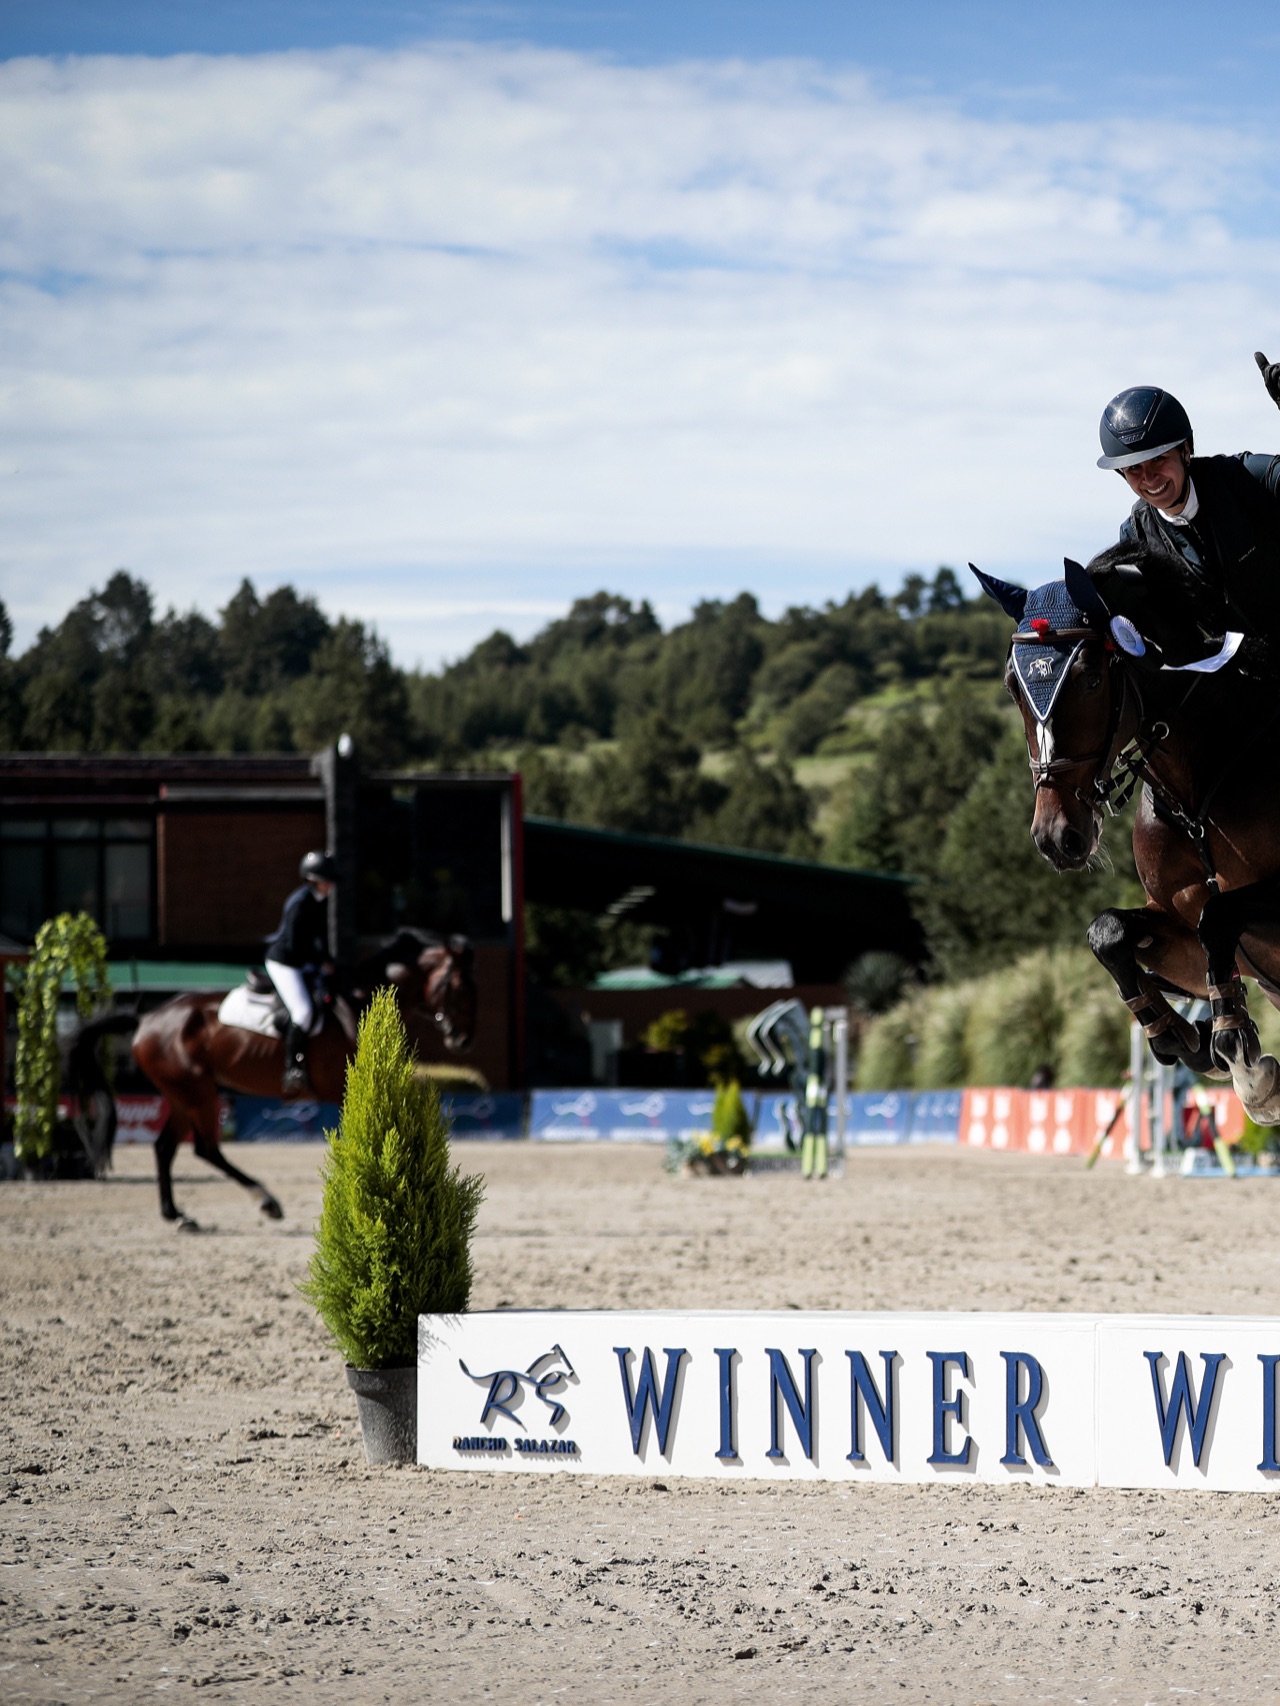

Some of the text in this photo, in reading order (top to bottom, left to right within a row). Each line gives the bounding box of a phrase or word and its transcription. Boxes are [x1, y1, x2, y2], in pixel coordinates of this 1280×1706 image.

[613, 1346, 1054, 1467] WINNER
[453, 1436, 508, 1452] RANCHO
[514, 1437, 577, 1454] SALAZAR
